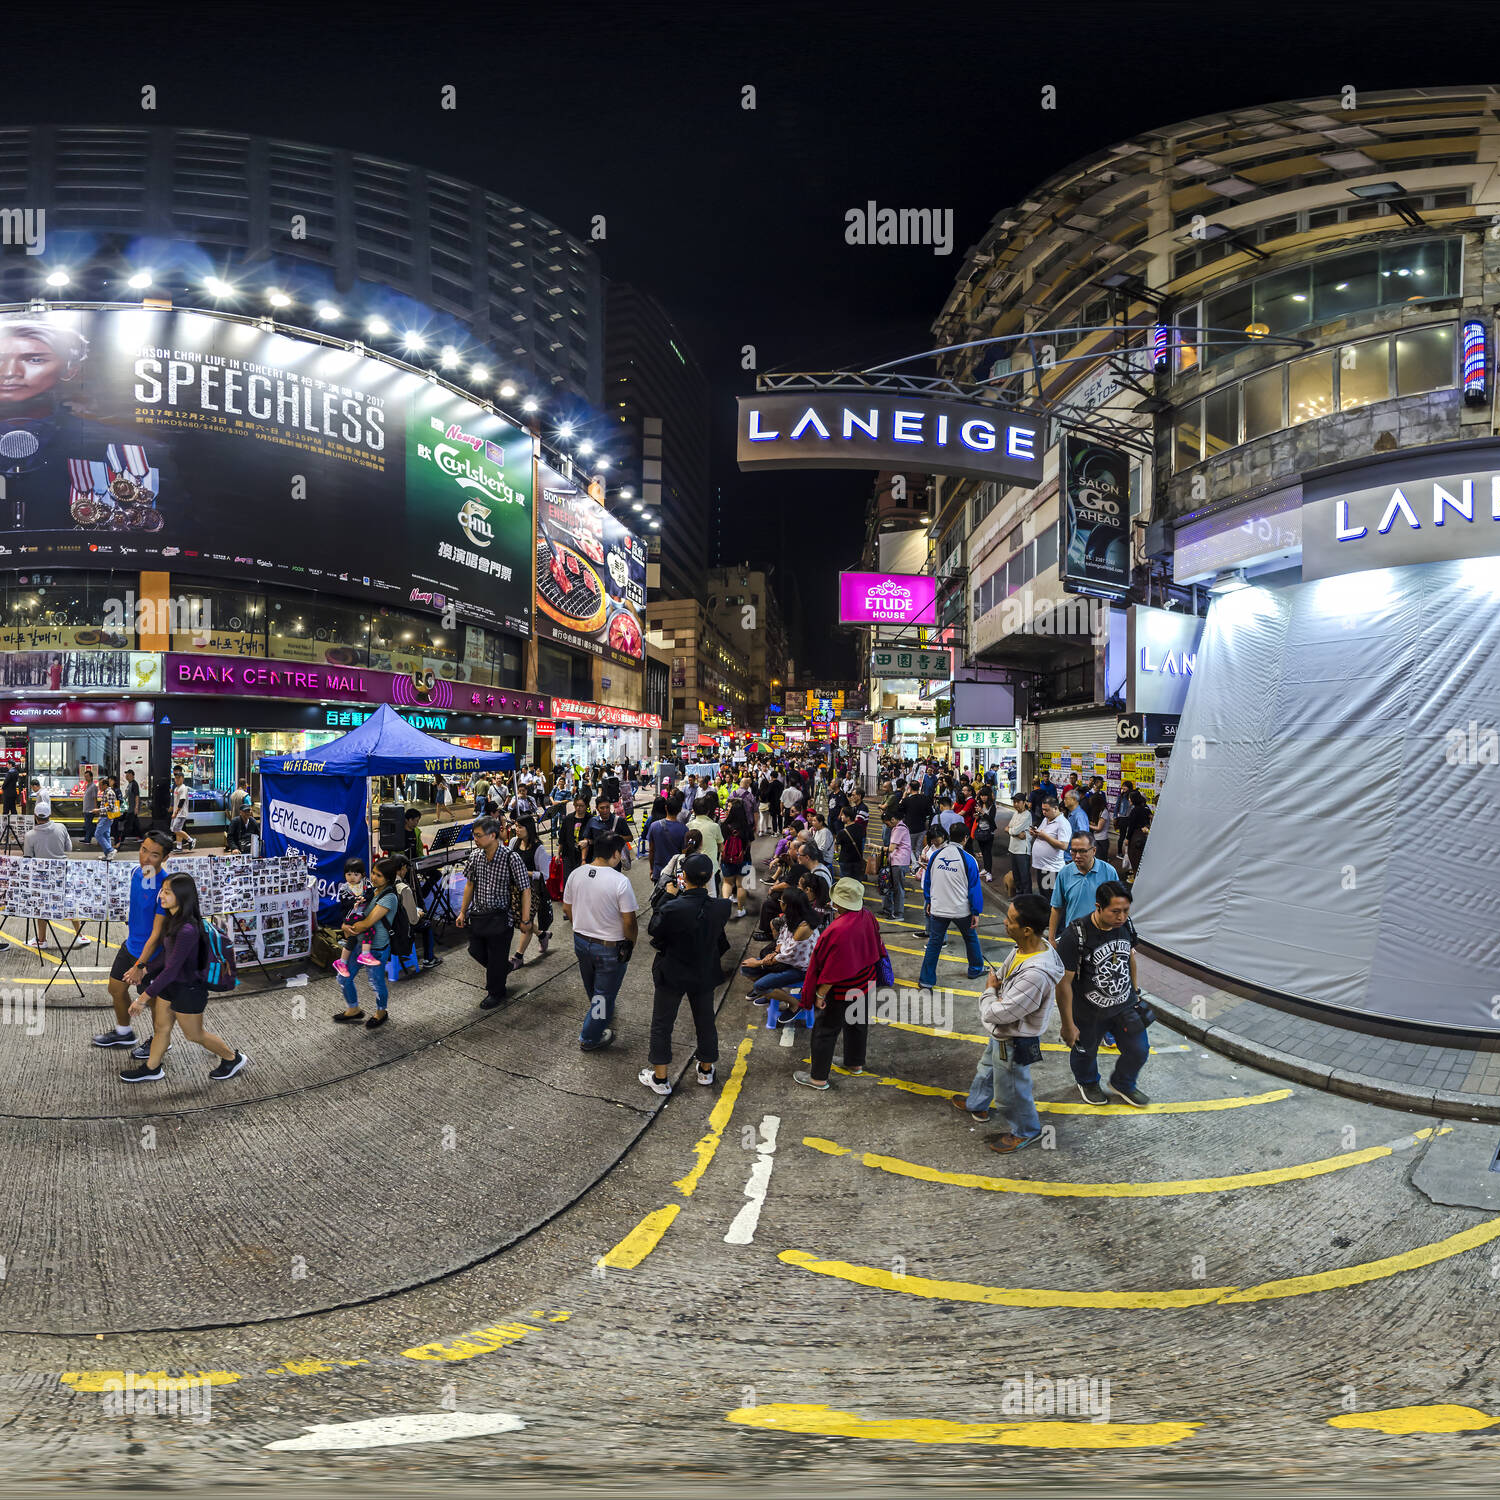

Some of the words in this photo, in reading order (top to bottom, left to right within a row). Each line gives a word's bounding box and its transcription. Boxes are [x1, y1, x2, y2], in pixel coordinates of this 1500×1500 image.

[174, 351, 201, 363] CHAN
[205, 354, 226, 367] LIVE
[229, 359, 240, 369] IN
[243, 361, 284, 379] CONCERT
[366, 394, 385, 408] 2017
[1084, 378, 1102, 400] SEX
[134, 358, 385, 451] SPEECHLESS
[445, 424, 484, 451] Neway
[749, 407, 1035, 460] LANEIGE
[434, 443, 513, 504] Carlsberg
[1079, 477, 1119, 495] SALON
[457, 511, 495, 538] CHILL
[1079, 510, 1120, 526] AHEAD
[409, 588, 432, 605] Neway
[865, 598, 913, 611] ETUDE
[872, 611, 905, 619] HOUSE
[876, 653, 947, 671] 田園書屋
[178, 665, 235, 684] BANK
[243, 668, 318, 688] CENTRE
[326, 674, 368, 693] MALL
[956, 731, 1013, 744] 田園書屋
[1117, 720, 1139, 738] Go
[303, 760, 325, 772] Band
[456, 758, 480, 770] Band
